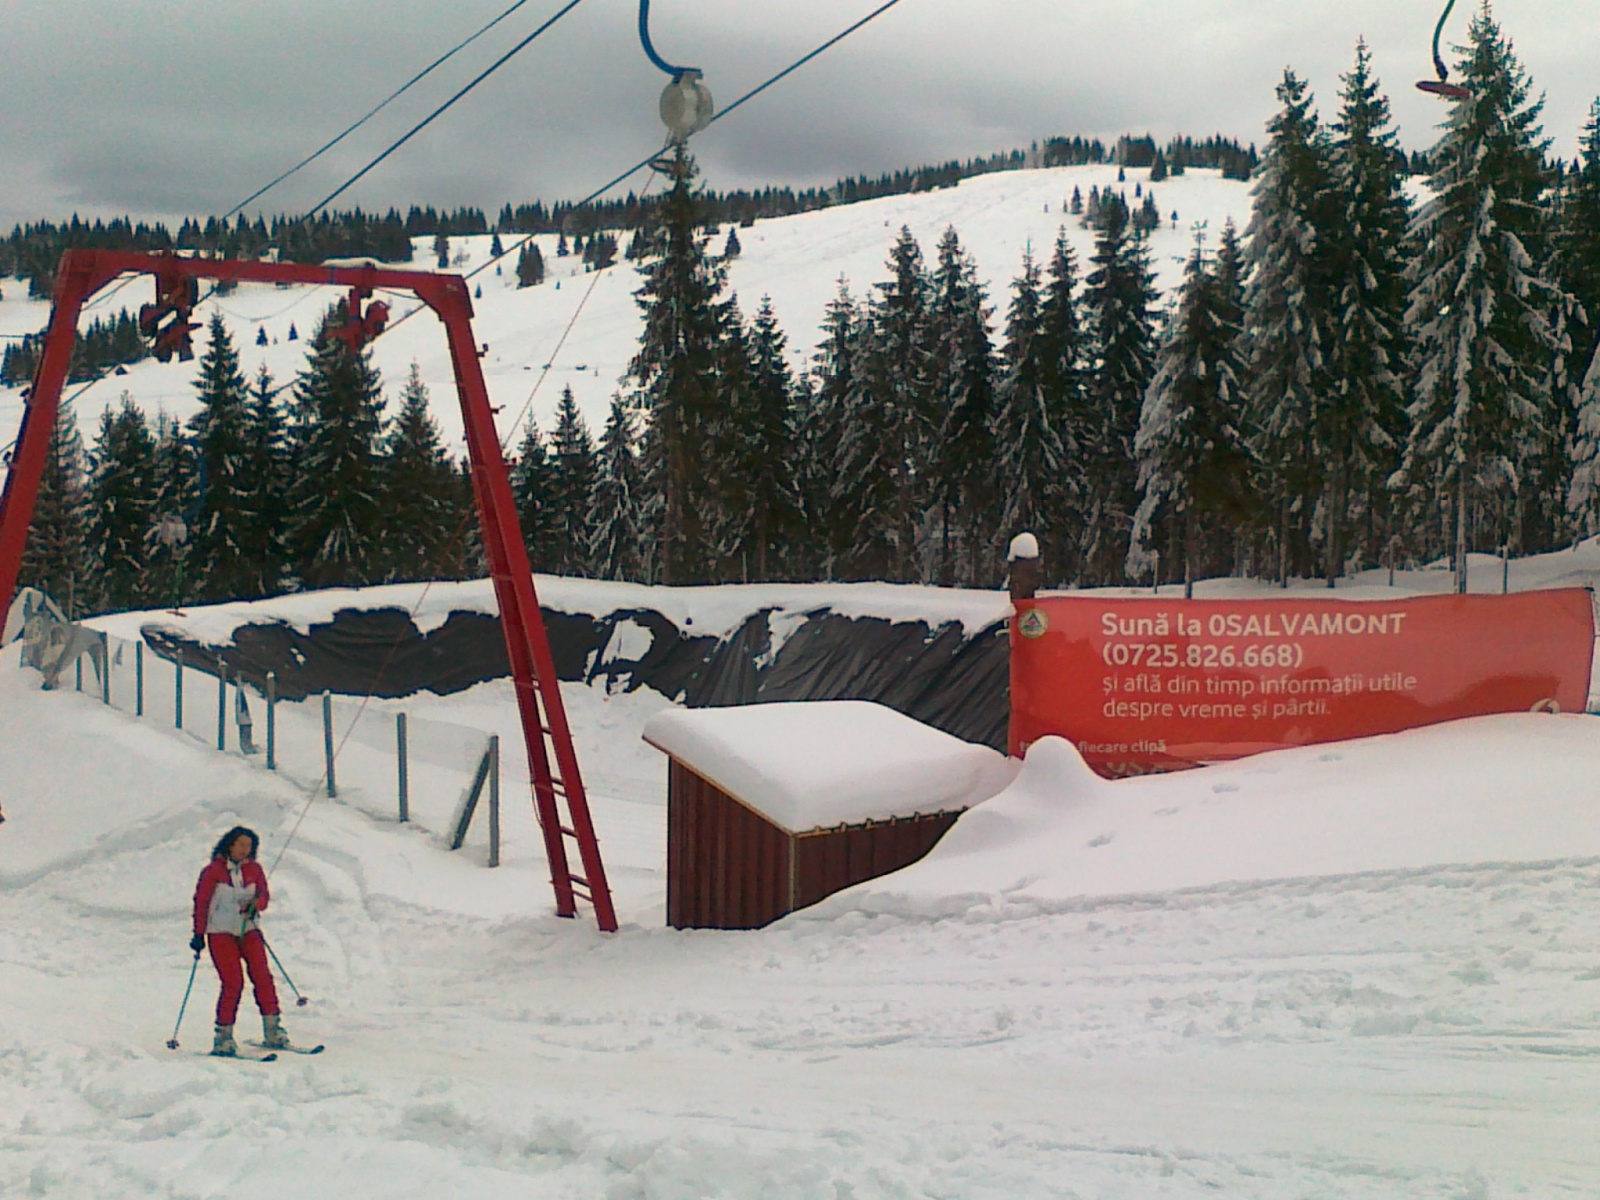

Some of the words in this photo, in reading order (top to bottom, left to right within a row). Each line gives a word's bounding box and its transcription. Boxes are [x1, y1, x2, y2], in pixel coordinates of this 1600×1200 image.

[1101, 612, 1169, 636] Sună
[1178, 613, 1201, 636] la
[1209, 612, 1407, 637] 0SALVAMONT
[1102, 643, 1303, 667] (0725.826.668)
[1103, 676, 1118, 695] și
[1124, 675, 1161, 692] află
[1168, 675, 1200, 692] din
[1205, 675, 1252, 697] timp
[1260, 675, 1363, 696] informații
[1369, 673, 1417, 691] utile
[1103, 699, 1172, 722] despre
[1179, 702, 1246, 718] vreme
[1252, 701, 1268, 720] și
[1273, 699, 1331, 719] pârtii.
[1079, 740, 1127, 753] fiecare
[1131, 740, 1167, 755] clipă
